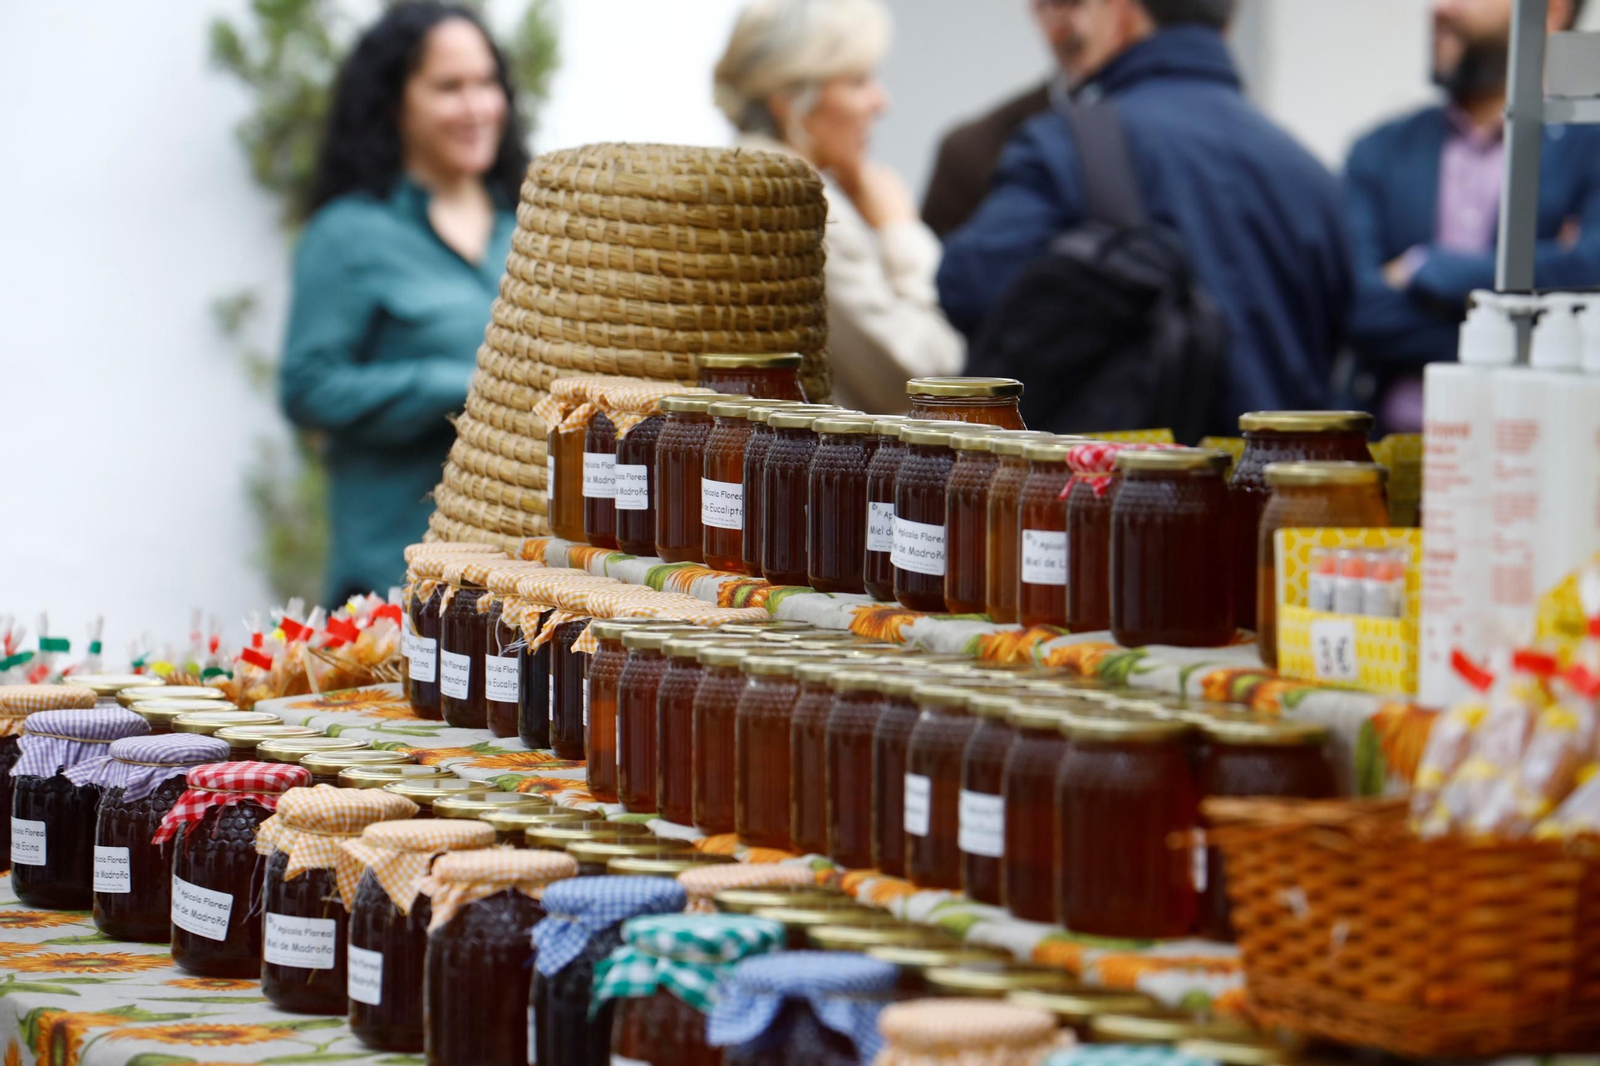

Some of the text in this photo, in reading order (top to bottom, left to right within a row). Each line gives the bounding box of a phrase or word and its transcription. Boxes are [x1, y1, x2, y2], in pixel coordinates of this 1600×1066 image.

[870, 526, 884, 536] Miel
[203, 897, 230, 911] Floreal
[190, 909, 227, 927] Madroño
[304, 928, 334, 939] Floreal
[291, 942, 333, 955] Madroño
